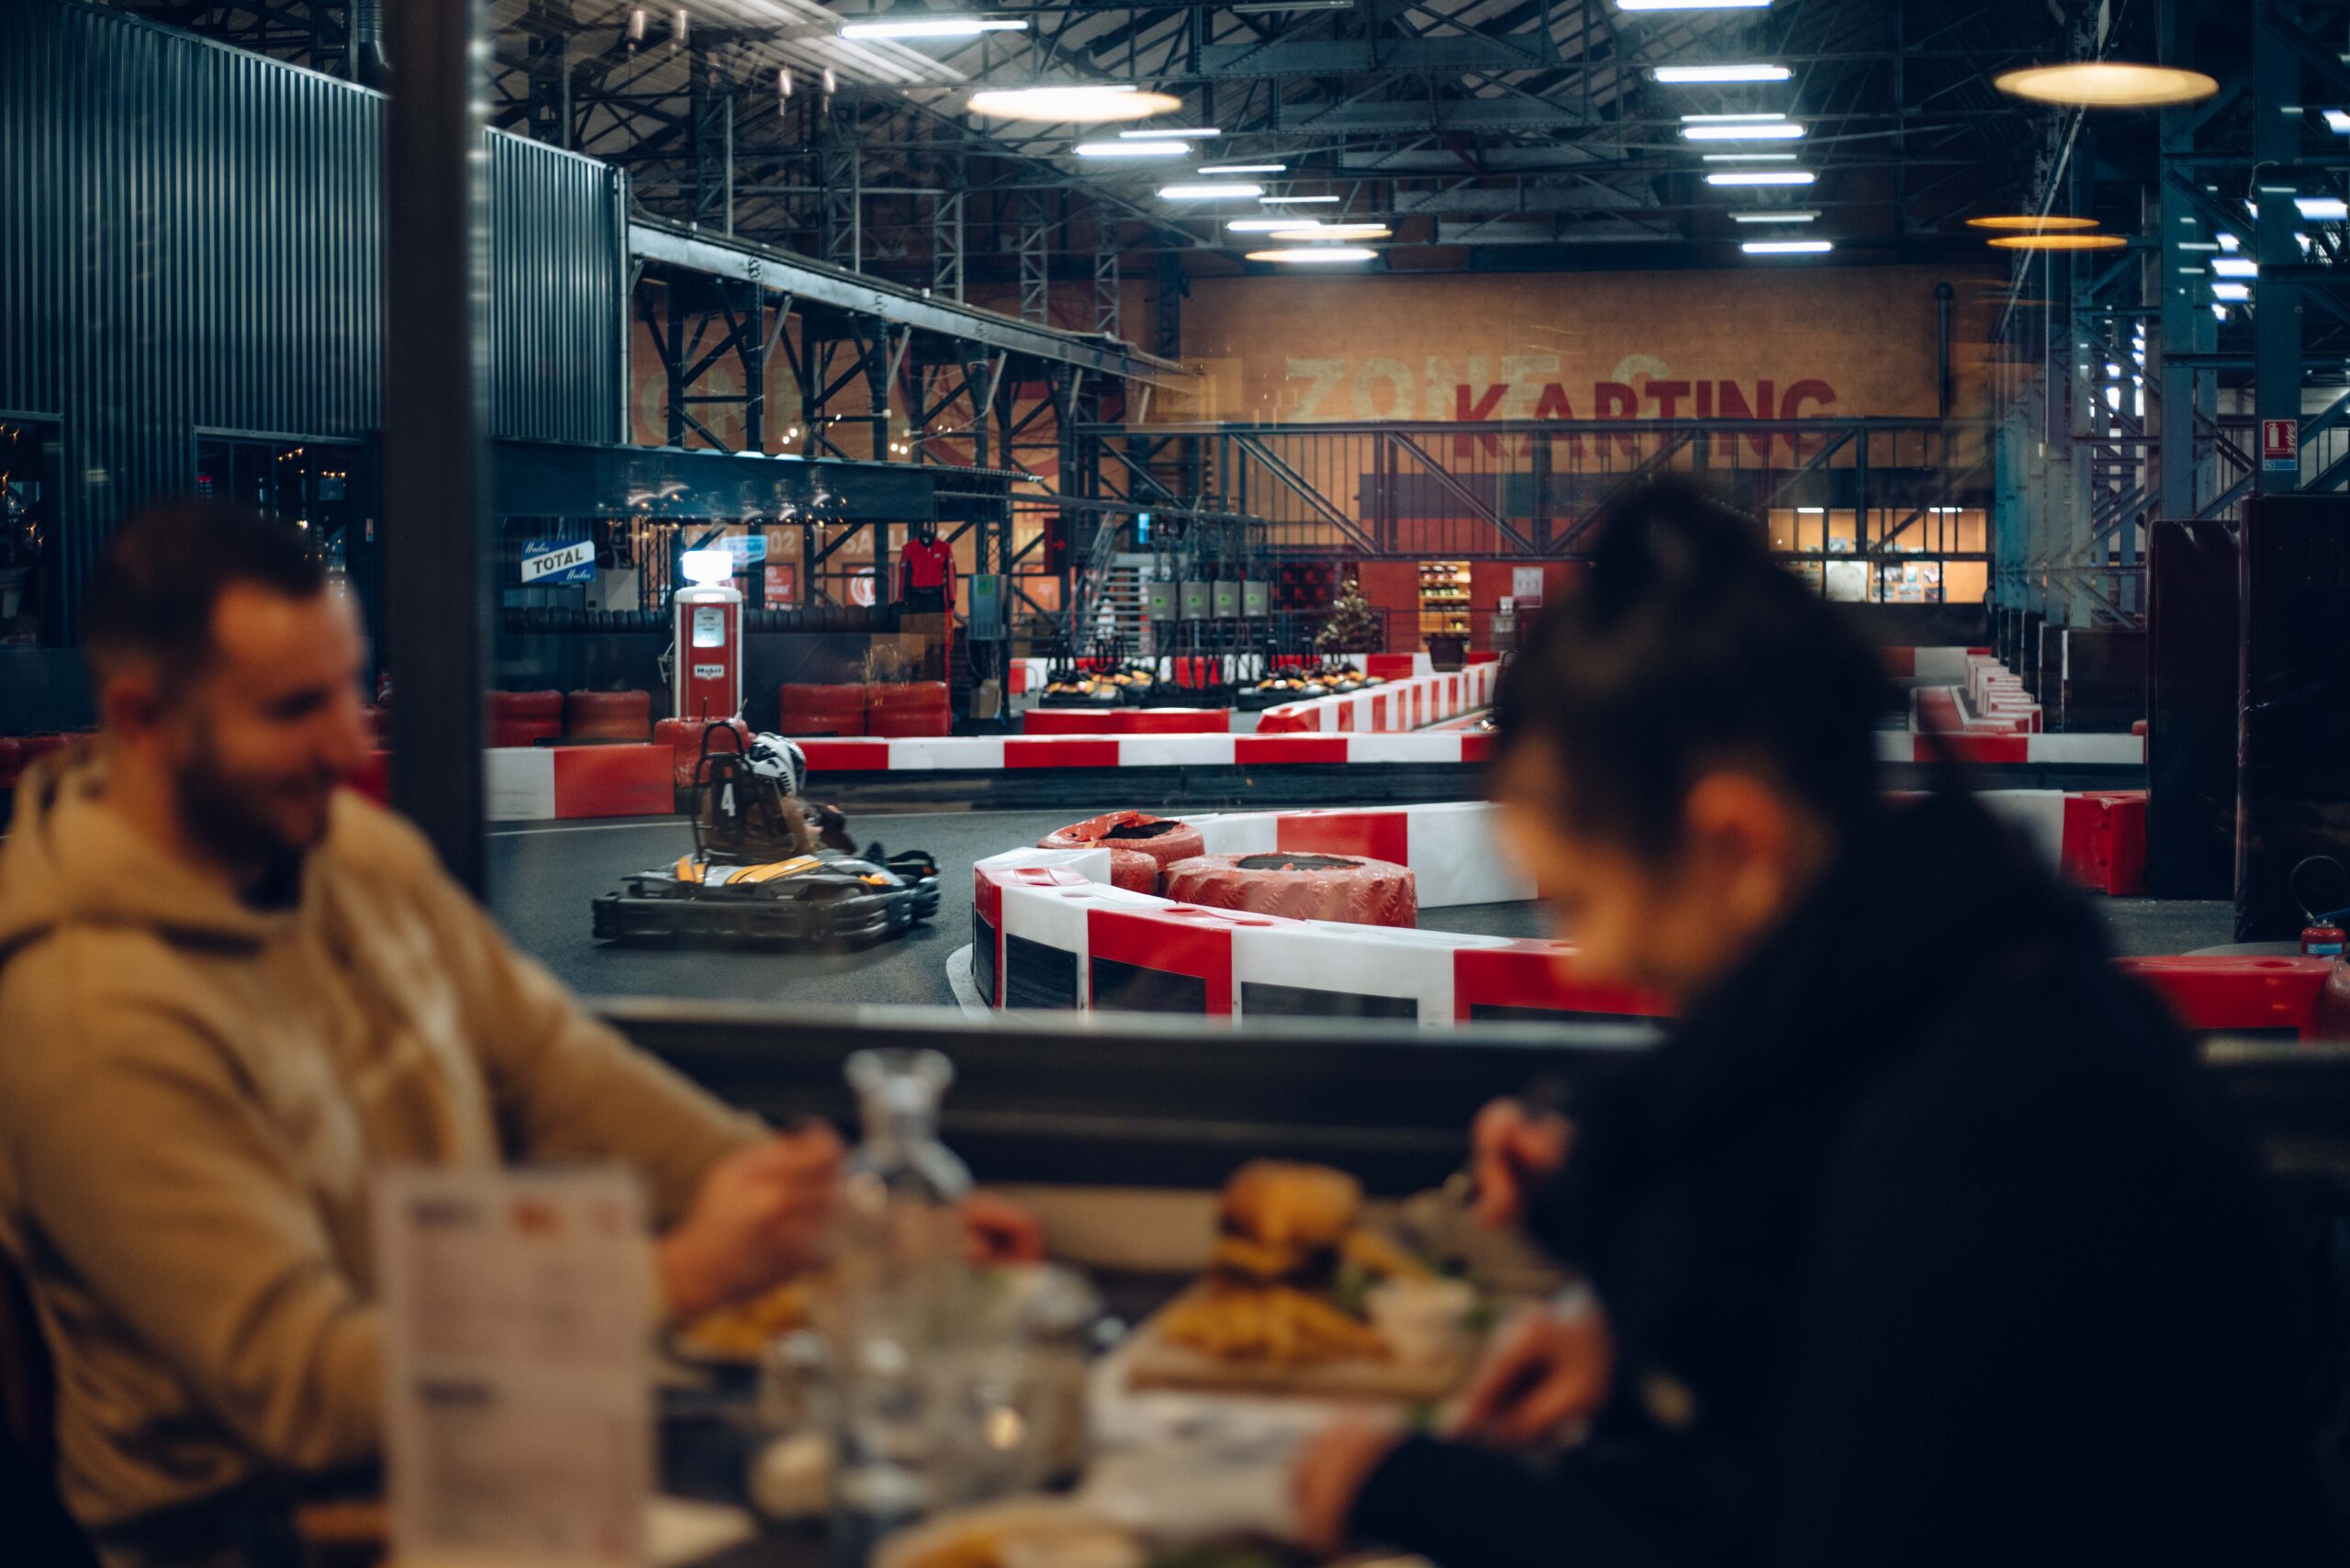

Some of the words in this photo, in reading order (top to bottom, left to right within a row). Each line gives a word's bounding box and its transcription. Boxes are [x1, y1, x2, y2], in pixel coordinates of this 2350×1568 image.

[1454, 378, 1837, 458] KARTING
[532, 547, 584, 575] TOTAL
[721, 782, 736, 817] 4
